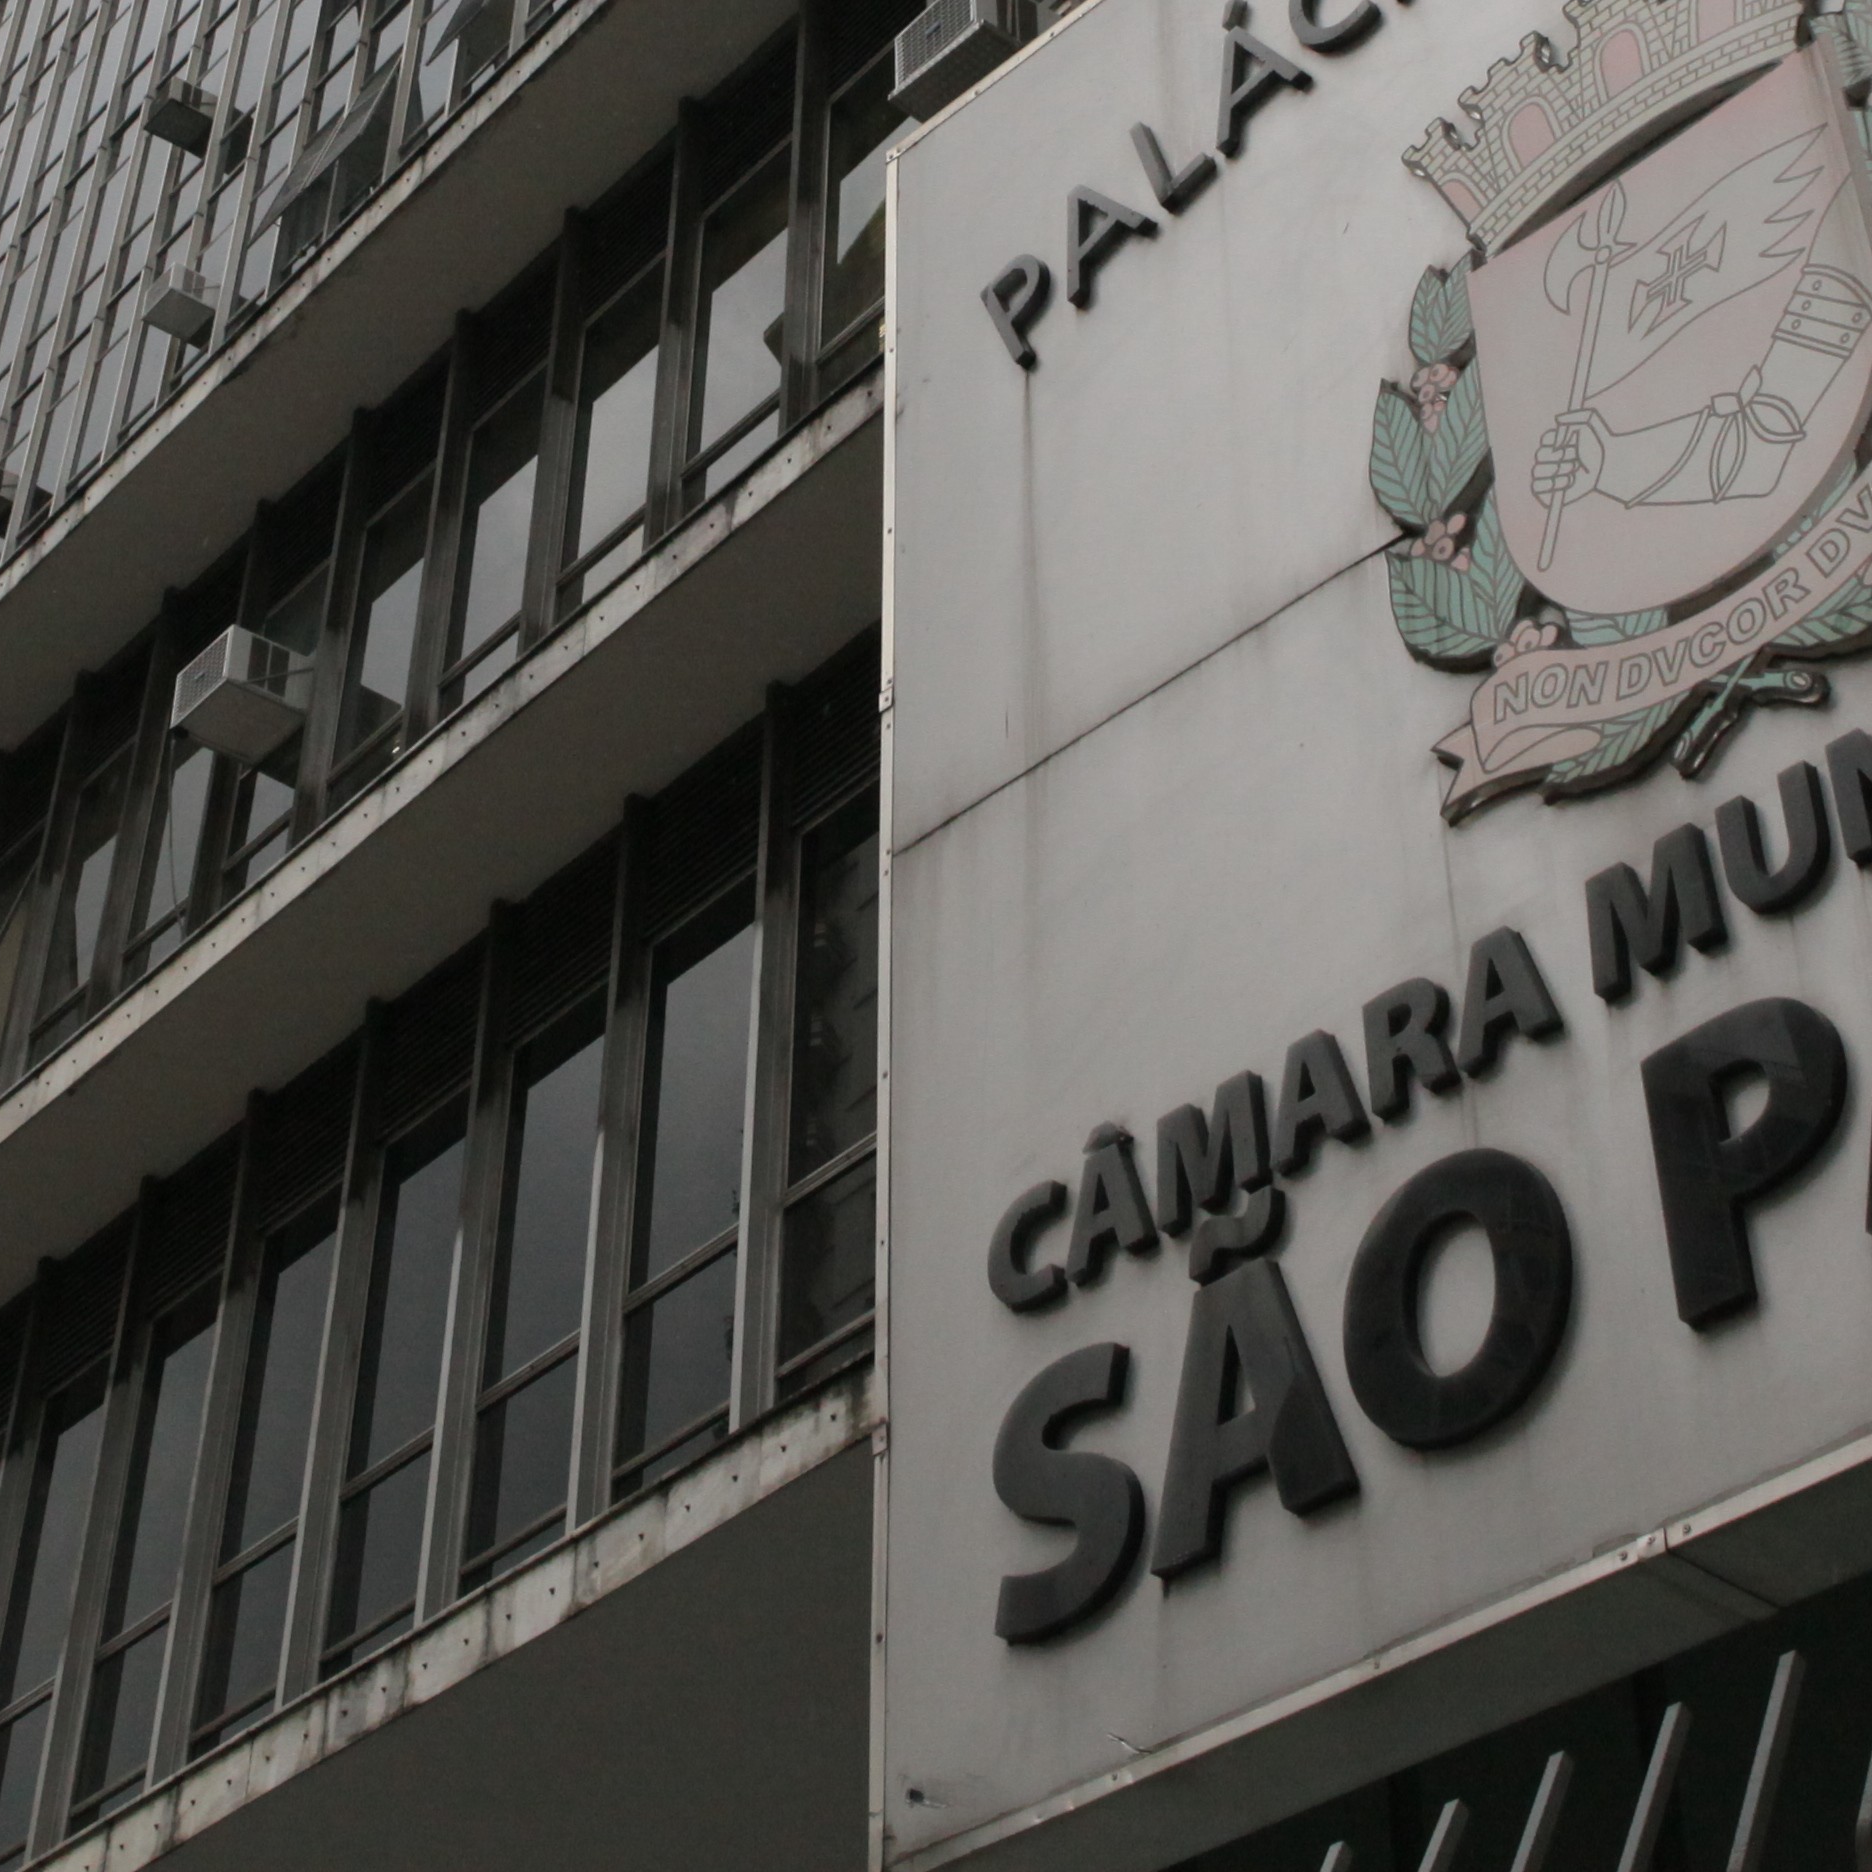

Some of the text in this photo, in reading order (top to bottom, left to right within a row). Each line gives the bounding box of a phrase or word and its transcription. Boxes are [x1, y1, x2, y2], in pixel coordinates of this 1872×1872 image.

[1492, 660, 1611, 724] NON
[1614, 566, 1812, 704] DVCOR
[986, 925, 1565, 1315] CÂMARA
[991, 1146, 1575, 1645] SÃO
